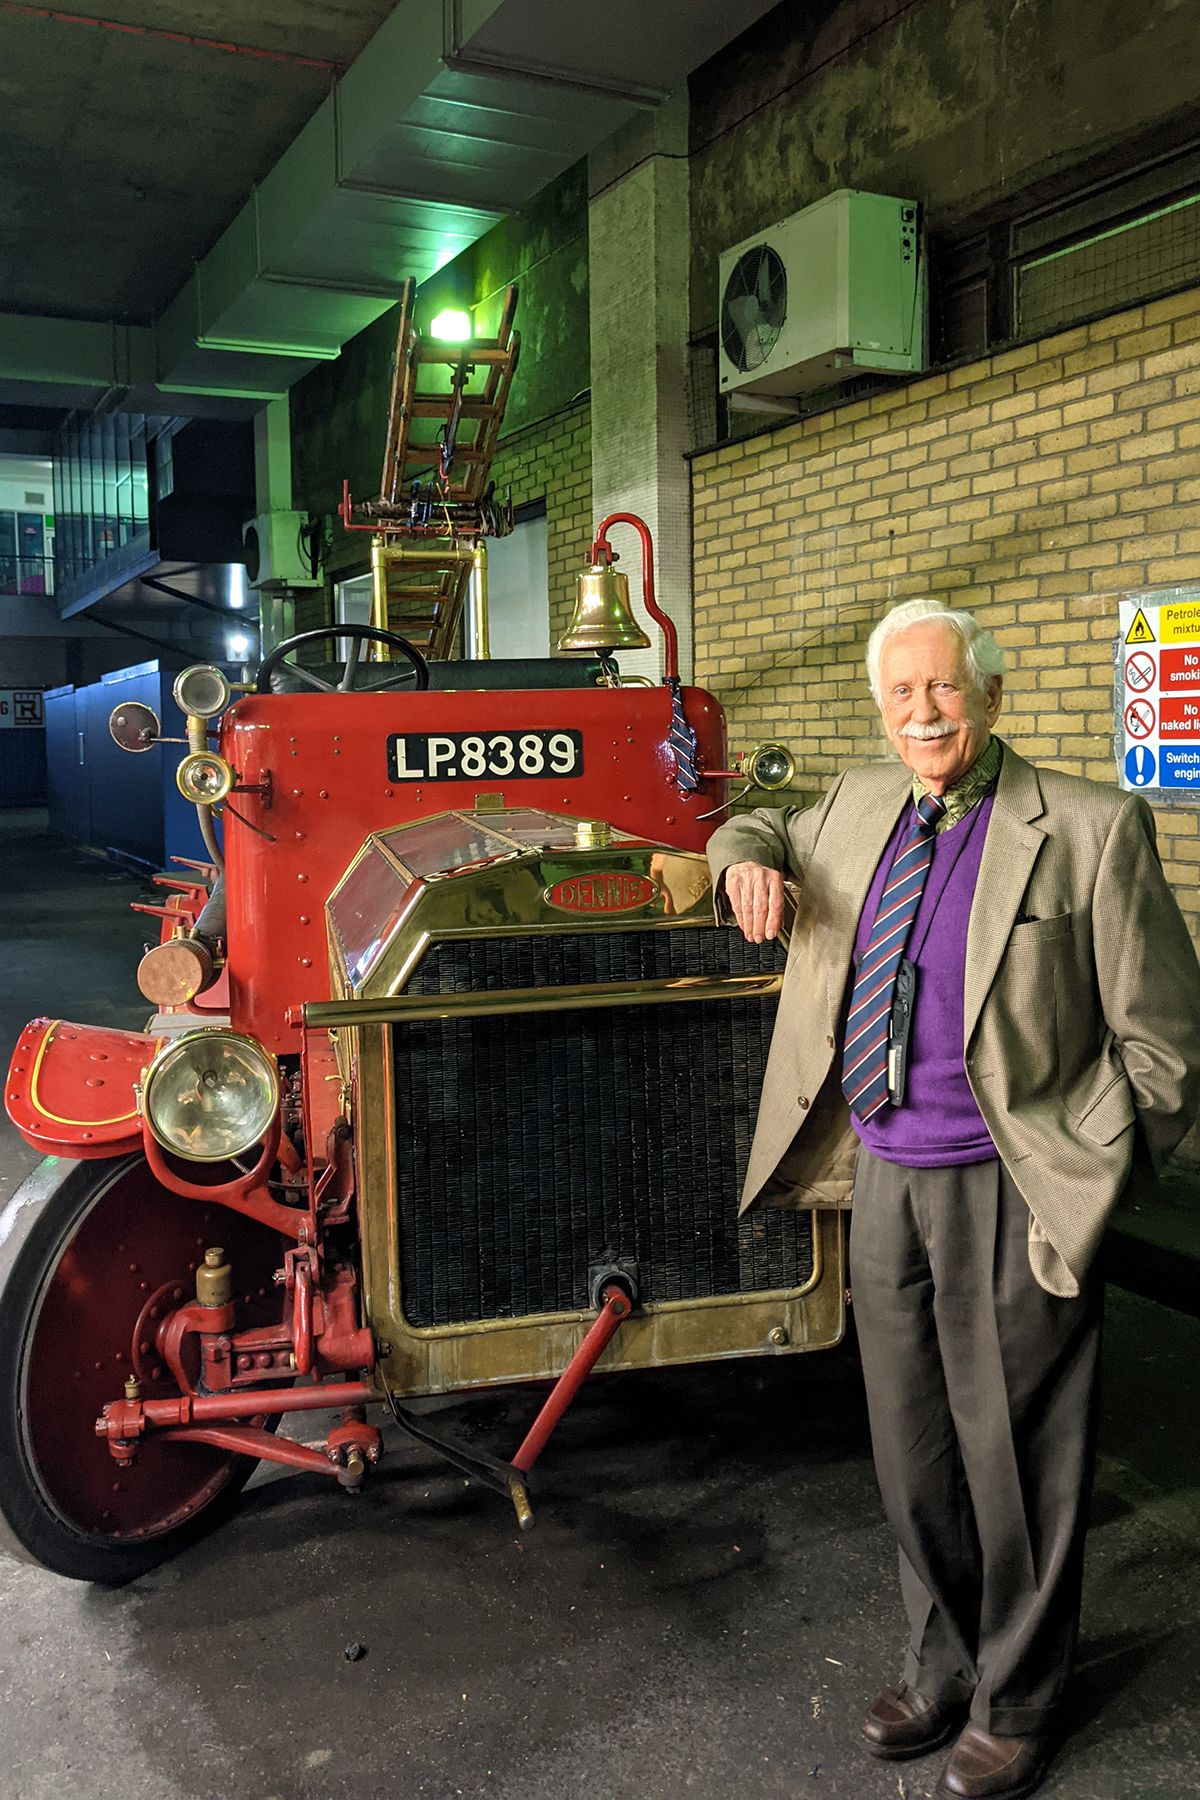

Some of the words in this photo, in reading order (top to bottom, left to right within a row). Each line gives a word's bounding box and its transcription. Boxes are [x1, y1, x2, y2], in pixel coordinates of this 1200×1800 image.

[1184, 654, 1199, 666] No
[1184, 704, 1199, 715] No
[1161, 719, 1192, 731] naked
[1166, 752, 1200, 764] Switch
[560, 878, 645, 908] DENNIS
